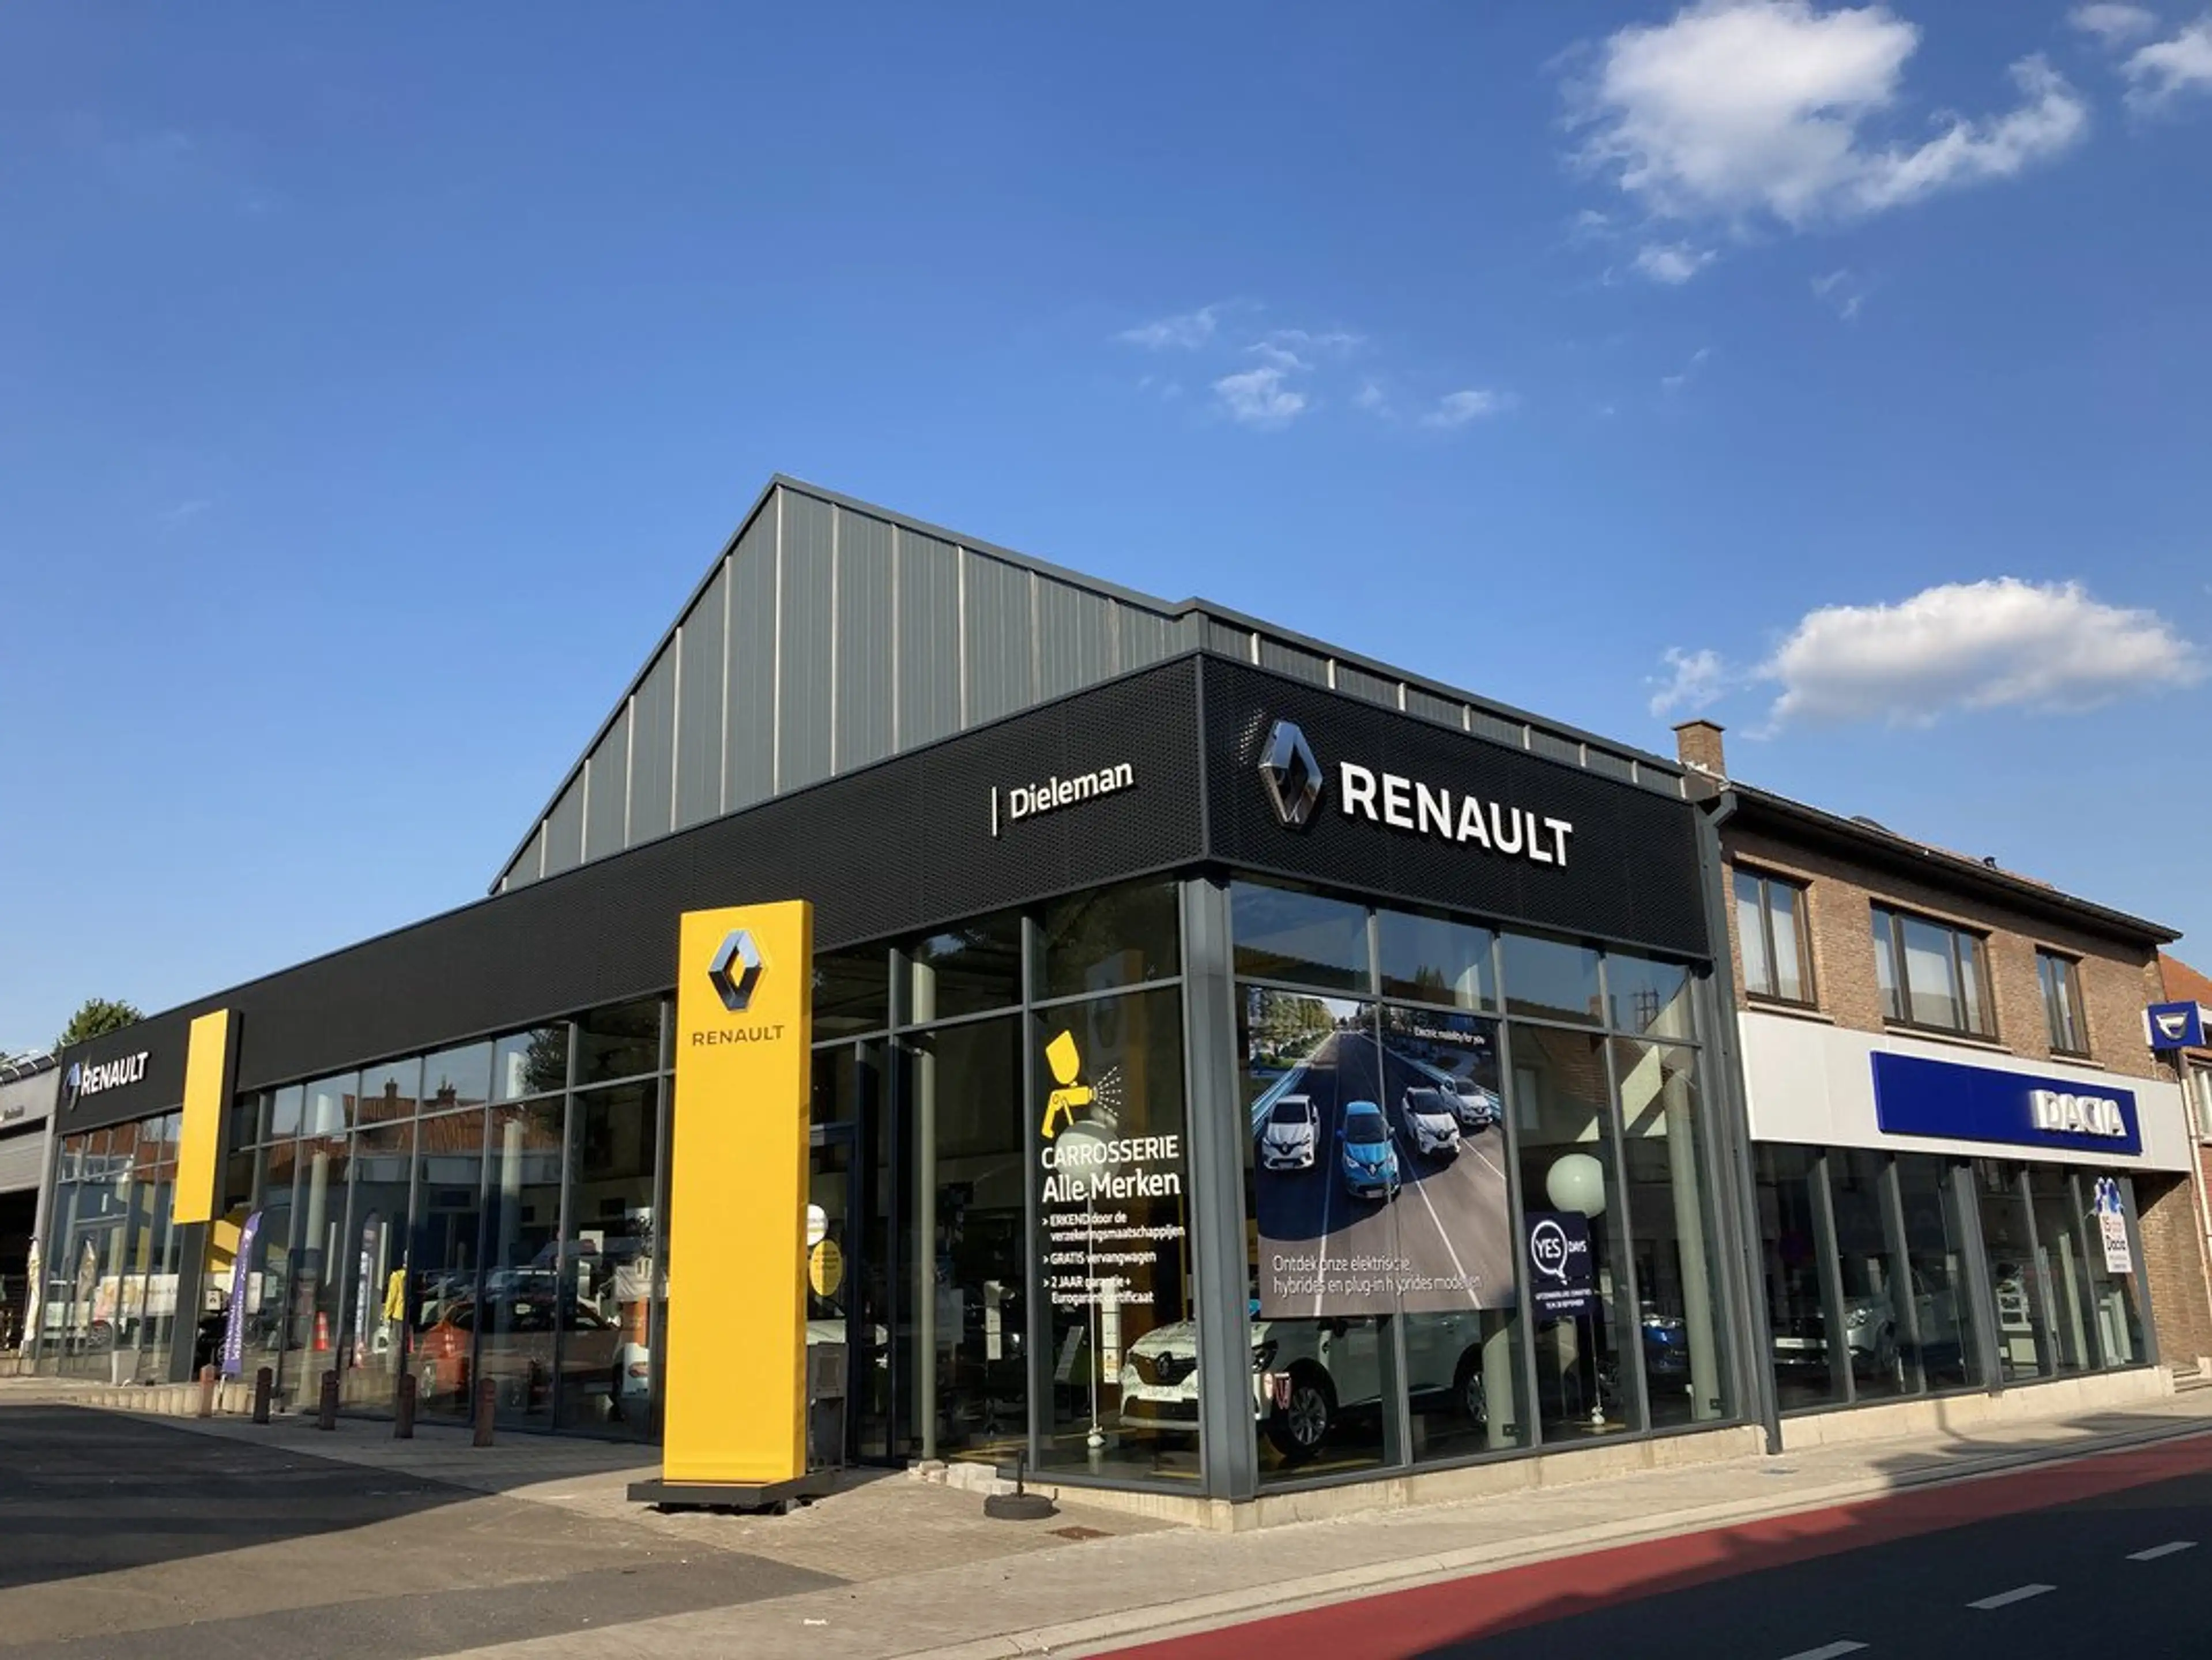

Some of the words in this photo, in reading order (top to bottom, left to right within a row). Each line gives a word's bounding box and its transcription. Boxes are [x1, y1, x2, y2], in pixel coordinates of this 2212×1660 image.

[1010, 763, 1133, 818] Dieleman
[1340, 761, 1573, 866] RENAULT
[692, 1025, 785, 1046] RENAULT
[81, 1052, 148, 1096] RENAULT
[2030, 1089, 2127, 1136] DACIA
[1041, 1135, 1180, 1169] CARROSSERIE
[1042, 1174, 1084, 1203] Alle
[1091, 1168, 1181, 1200] Merken
[1050, 1213, 1089, 1227] ERKEND
[1092, 1212, 1113, 1225] door
[1114, 1210, 1127, 1224] de
[1050, 1251, 1085, 1265] GRATIS
[1535, 1238, 1561, 1258] YES
[1273, 1255, 1317, 1272] Ontdek
[1320, 1259, 1350, 1272] onze
[1051, 1276, 1057, 1288] 2
[1058, 1275, 1084, 1288] JAAR
[1273, 1276, 1325, 1298] hybrides
[1328, 1280, 1343, 1293] en
[1346, 1274, 1385, 1296] plug-in
